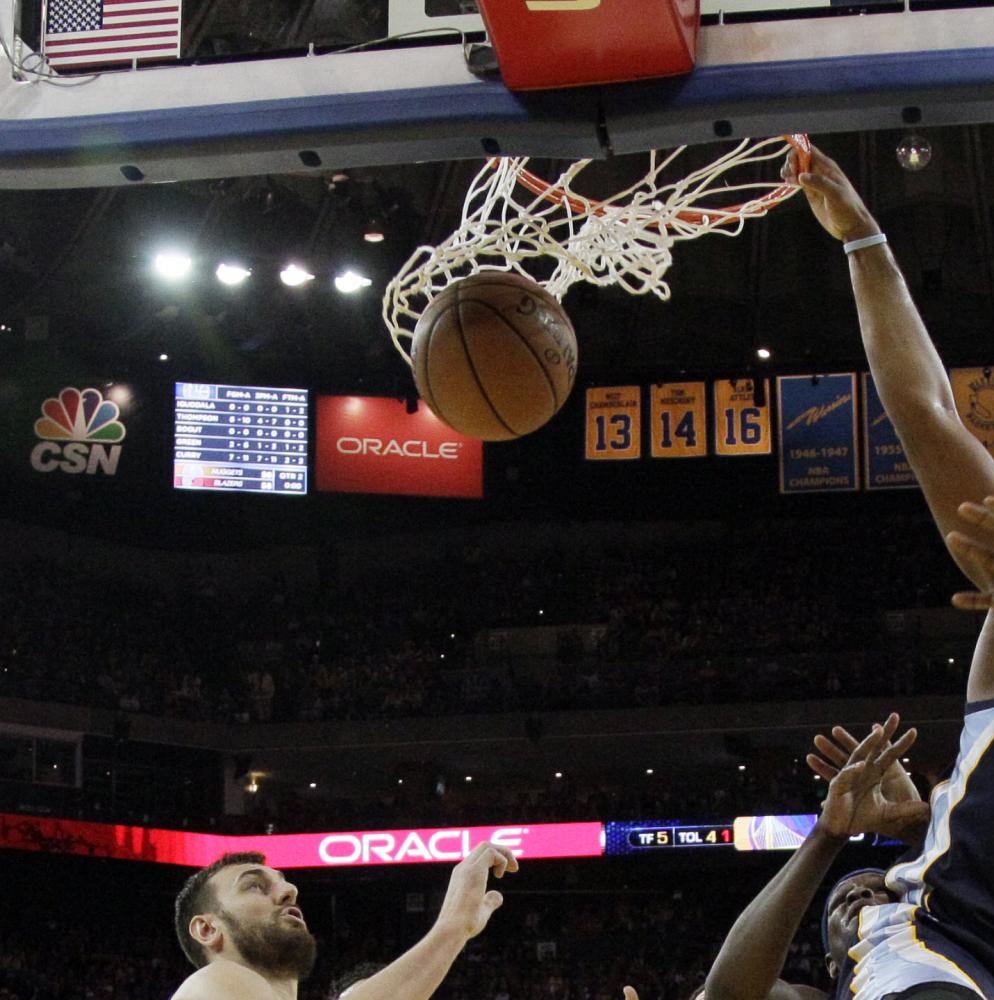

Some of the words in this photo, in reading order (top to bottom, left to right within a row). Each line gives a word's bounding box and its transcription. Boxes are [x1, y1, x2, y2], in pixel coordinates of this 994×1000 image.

[595, 413, 632, 451] 13
[661, 410, 697, 448] 14
[725, 408, 761, 446] 16
[31, 441, 122, 476] CSN
[337, 437, 458, 459] ORACLE
[638, 833, 654, 844] TF
[656, 831, 668, 844] 5
[679, 831, 703, 843] TOL
[705, 830, 717, 843] 4
[721, 829, 730, 842] 1
